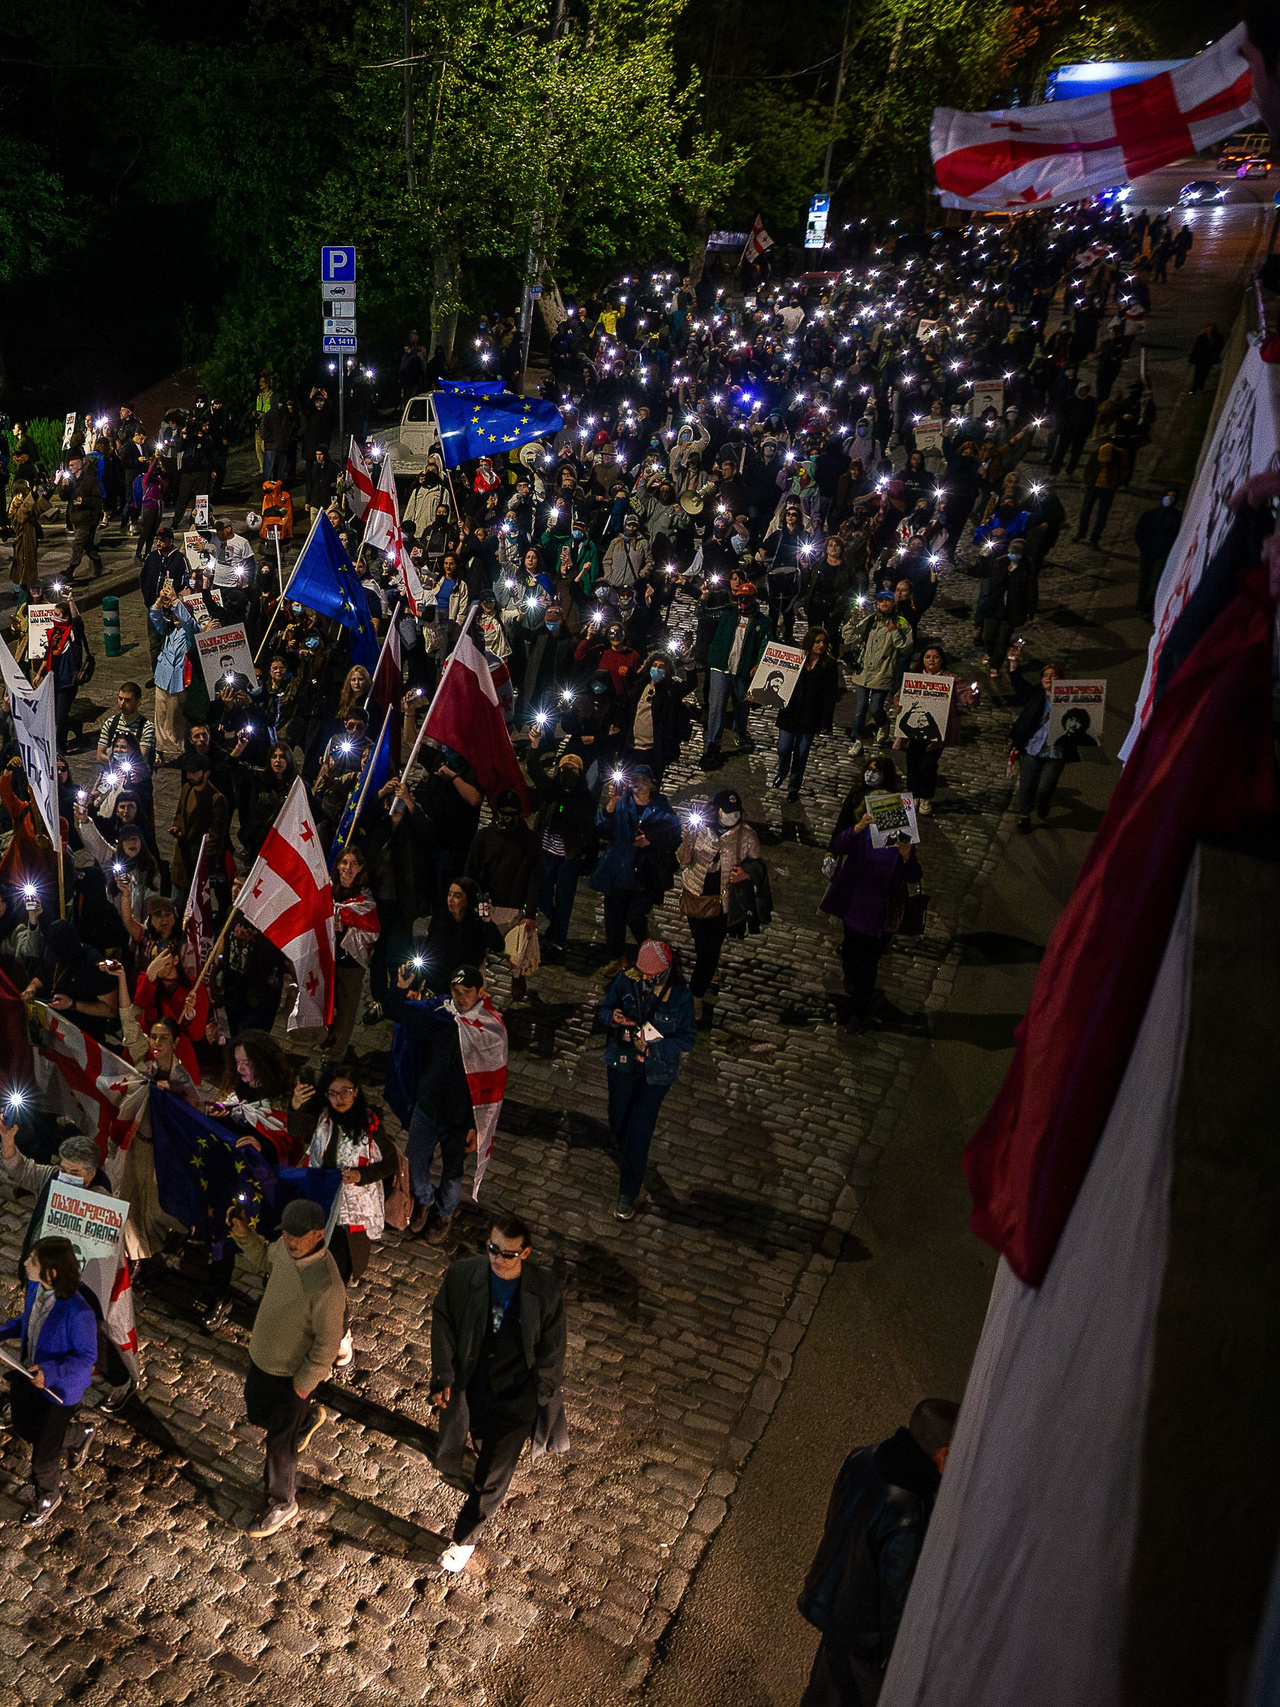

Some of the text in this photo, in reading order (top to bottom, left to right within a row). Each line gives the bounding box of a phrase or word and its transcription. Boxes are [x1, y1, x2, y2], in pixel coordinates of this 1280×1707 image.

[814, 198, 826, 211] P
[329, 250, 348, 278] P
[328, 337, 354, 345] A 1411
[198, 630, 245, 649] თავისუფლება
[766, 647, 804, 664] თავისუფლება
[904, 679, 950, 691] თავისუფლება
[50, 1192, 123, 1229] თავისუფლება
[47, 1209, 82, 1232] ანტონ
